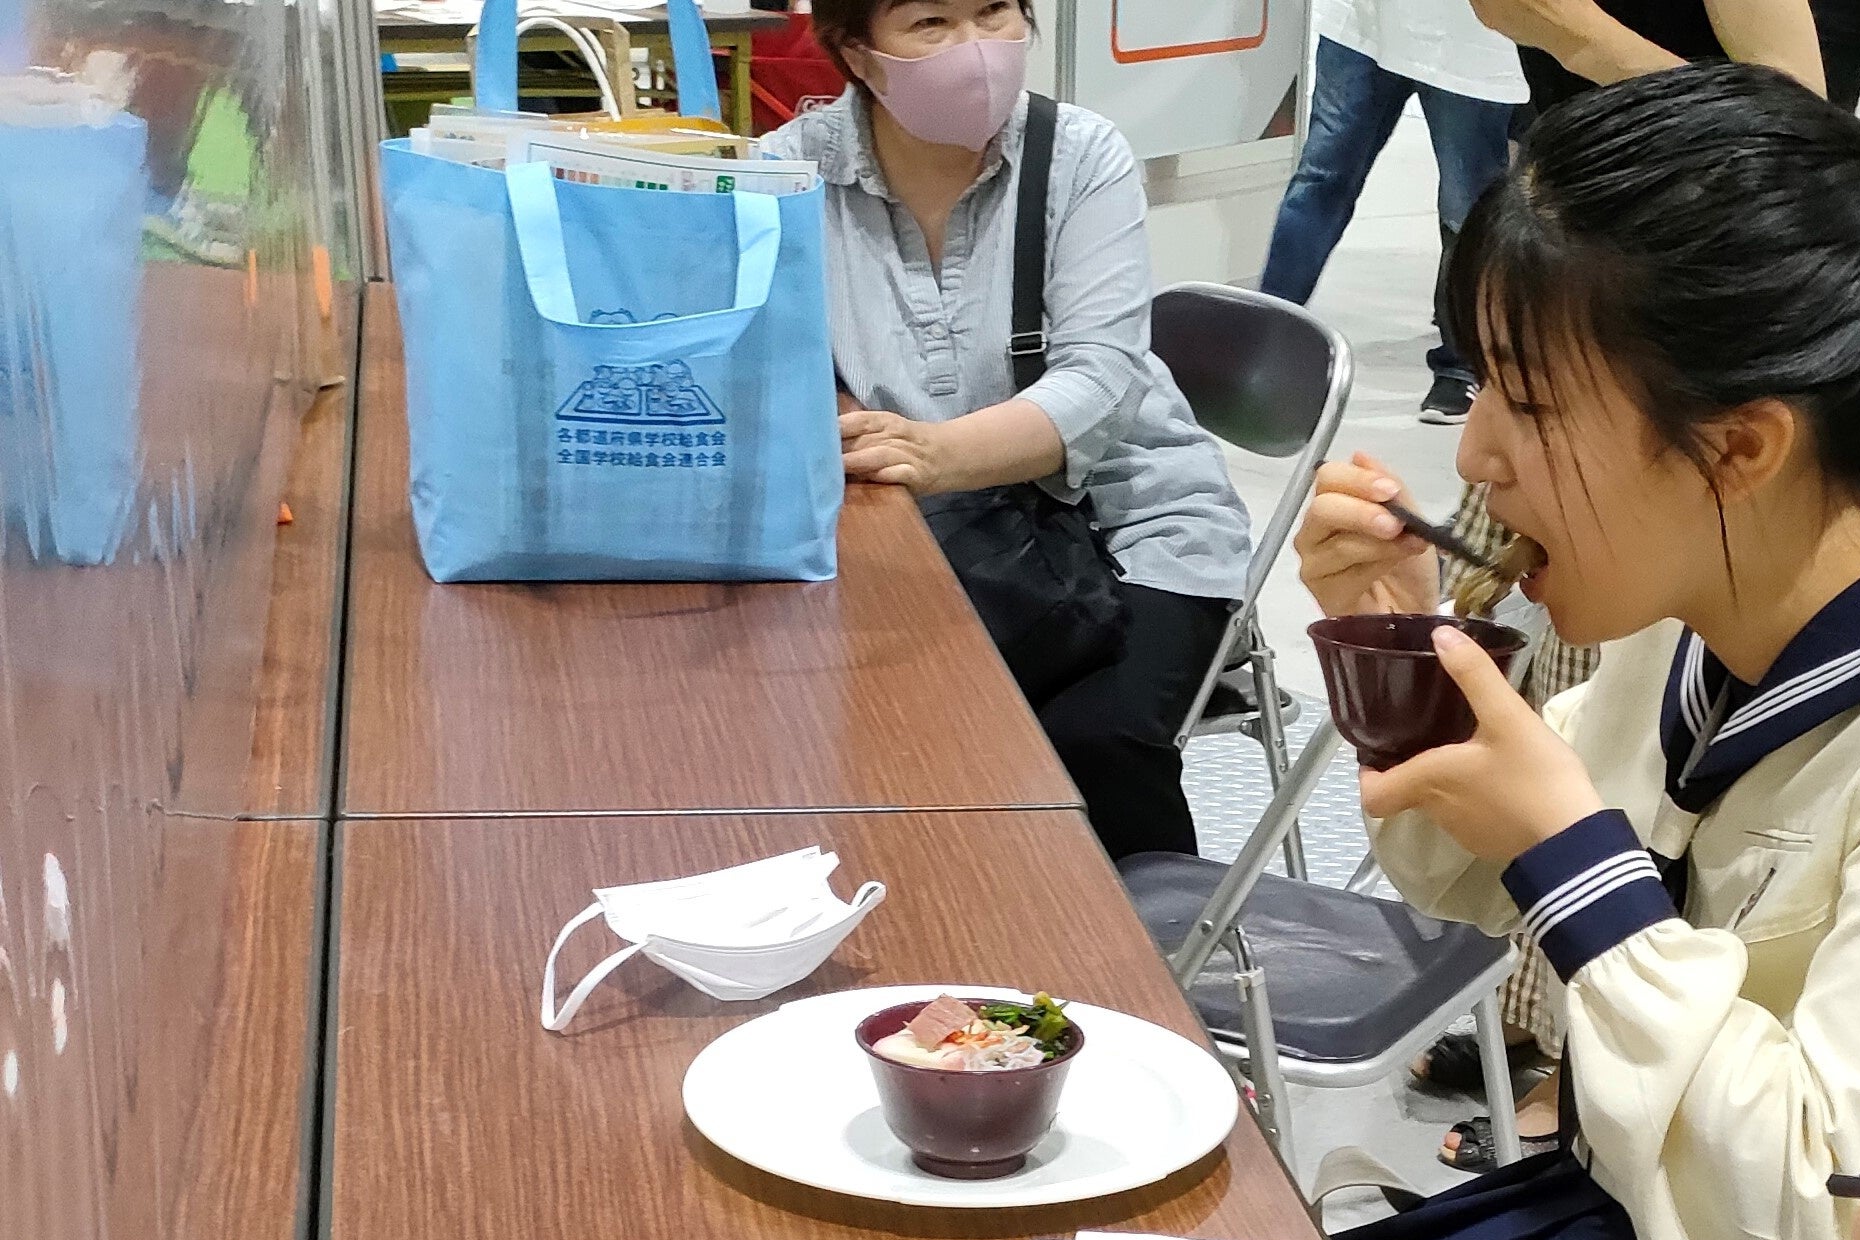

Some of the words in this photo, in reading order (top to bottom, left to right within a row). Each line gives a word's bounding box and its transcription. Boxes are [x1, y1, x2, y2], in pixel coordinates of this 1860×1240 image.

[556, 427, 727, 447] 各都道府県学校給食会
[556, 448, 727, 467] 全国学校給食会連合会
